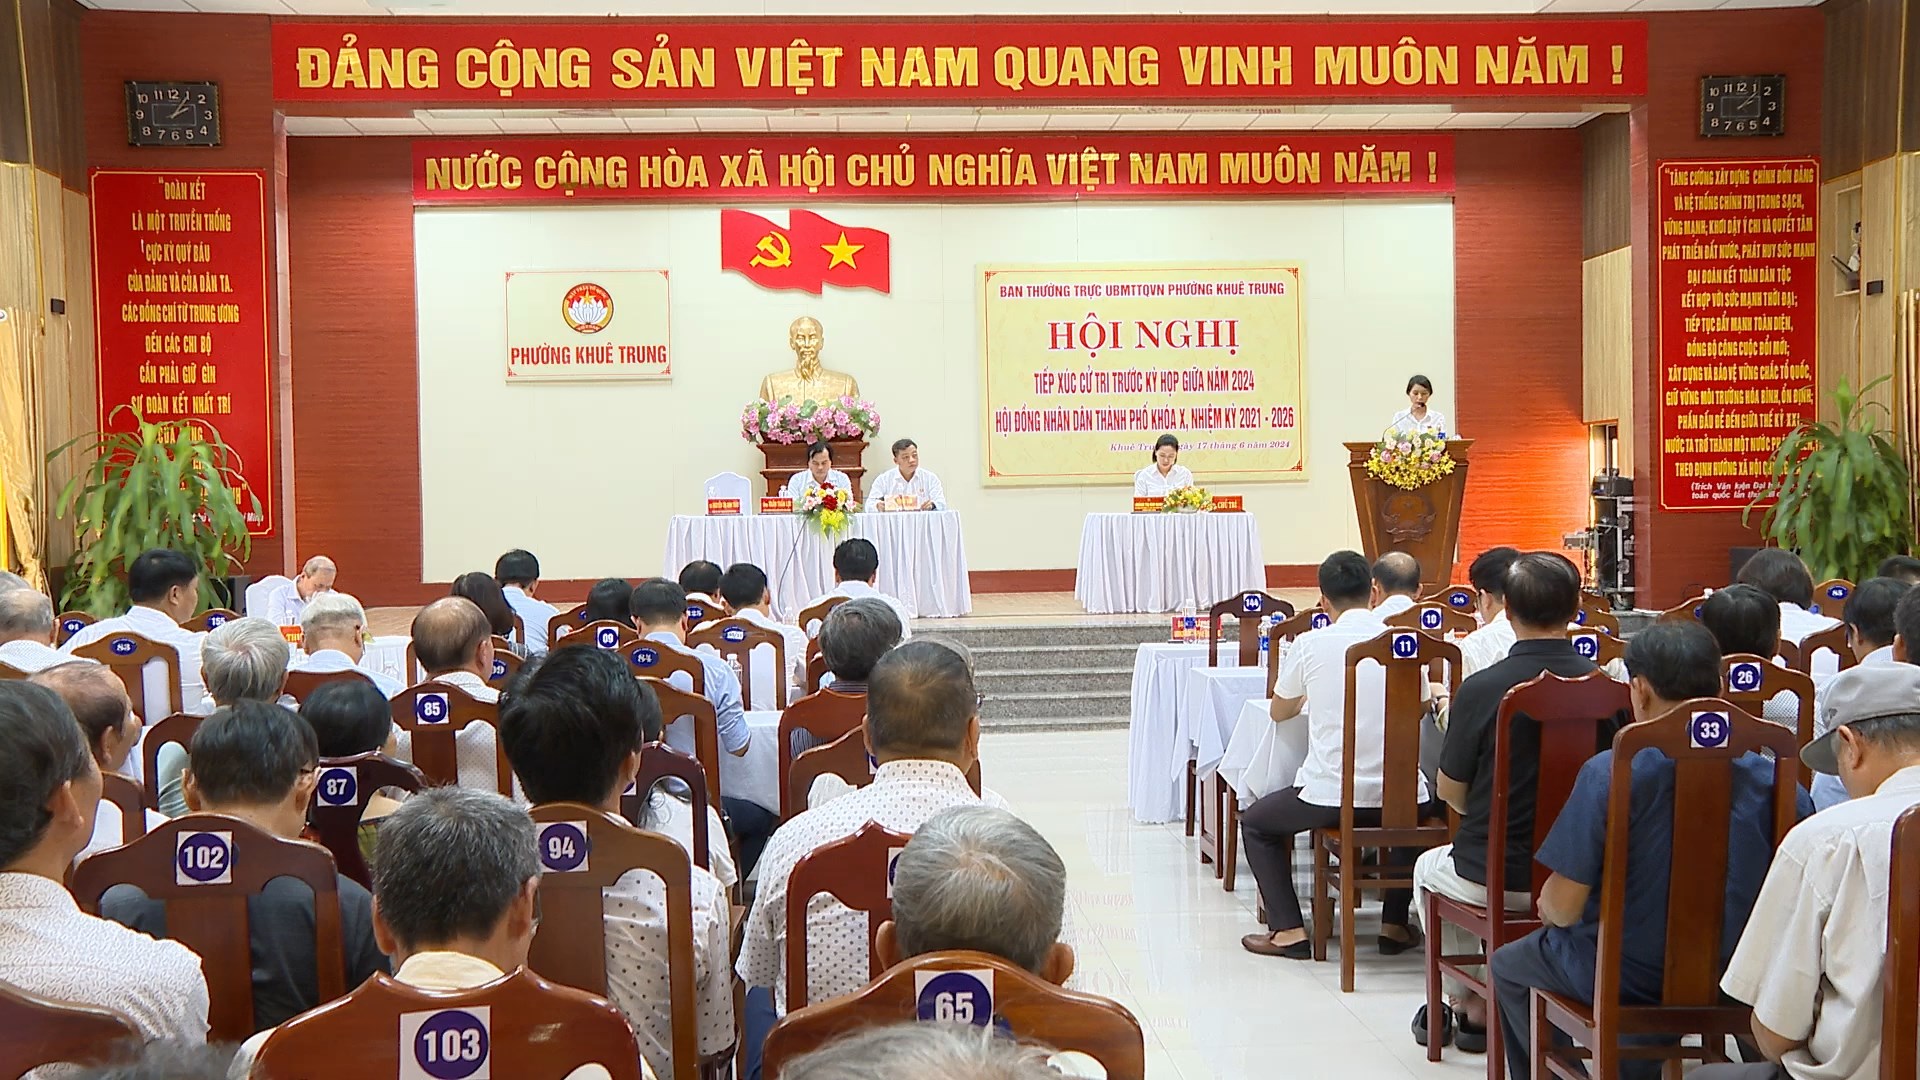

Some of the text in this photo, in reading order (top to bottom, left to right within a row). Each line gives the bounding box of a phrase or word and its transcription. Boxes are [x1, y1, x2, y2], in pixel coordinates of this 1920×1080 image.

[297, 34, 1622, 96] ĐẢNG CỘNG SẢN VIỆT NAM QUANG VINH MUÔN NĂM !
[138, 94, 148, 104] 10
[154, 91, 163, 100] 11
[168, 89, 179, 99] 12
[185, 91, 190, 99] 1
[198, 95, 206, 104] 2
[135, 111, 144, 120] 9
[204, 111, 212, 120] 3
[142, 126, 151, 136] 8
[157, 130, 166, 139] 7
[171, 131, 180, 140] 6
[185, 130, 194, 139] 5
[200, 126, 208, 136] 4
[426, 144, 1436, 195] NƯỚC CỘNG HÒA XÃ HỘI CHỦ NGHĨA VIỆT NAM MUÔN NĂM !
[190, 177, 205, 200] KẾT
[132, 208, 231, 234] LÀ MỘT TRUYỀN THỐNG
[146, 241, 210, 265] CỰC KỲ QUÝ BÁU
[128, 268, 233, 293] CỦA ĐẢNG VÀ CỦA DÂN TA.
[1000, 281, 1284, 297] BAN THƯỜNG TRỰC UBMTTQVN PHƯỜNG KHUÊ TRUNG
[122, 300, 239, 323] CÁC ĐỒNG CHÍ TỪ TRUNG ƯƠNG
[145, 329, 211, 356] ĐẾN CÁC CHI BỘ
[1048, 313, 1239, 358] HỘI NGHỊ
[511, 342, 666, 365] PHƯỜNG KHUÊ TRUNG
[140, 360, 216, 383] CẦN PHẢI GIỮ GÌN
[1034, 365, 1254, 396] TIẾP XÚC CỬ TRI TRƯỚC KỲ HỌP GIỮA NĂM 2024
[147, 393, 168, 414] ĐOÀN
[172, 390, 188, 414] KẾT
[193, 391, 213, 414] NHẤT
[217, 393, 231, 414] TRÍ
[996, 407, 1011, 437] HỘI
[1014, 402, 1041, 432] ĐỒNG
[1044, 406, 1070, 431] NHÂN
[1073, 406, 1092, 431] DÂN
[1095, 404, 1126, 431] THÀNH
[1129, 401, 1148, 430] PHỐ
[1151, 405, 1177, 430] KHÓA
[1180, 409, 1188, 431] X,
[1192, 405, 1221, 433] NHIỆM
[1224, 403, 1236, 429] KỲ
[1240, 408, 1260, 428] 2021
[1272, 407, 1293, 427] 2026
[1110, 443, 1135, 451] Khuê
[1210, 442, 1236, 451] tháng
[1425, 615, 1437, 624] 10
[602, 635, 614, 644] 09
[1399, 640, 1411, 652] 11
[1578, 643, 1591, 654] 12
[1737, 670, 1753, 684] 26
[423, 702, 441, 717] 85
[1700, 722, 1720, 739] 33
[326, 778, 347, 796] 87
[548, 837, 575, 859] 94
[183, 845, 224, 869] 102
[934, 992, 974, 1024] 65
[422, 1030, 482, 1062] 103
